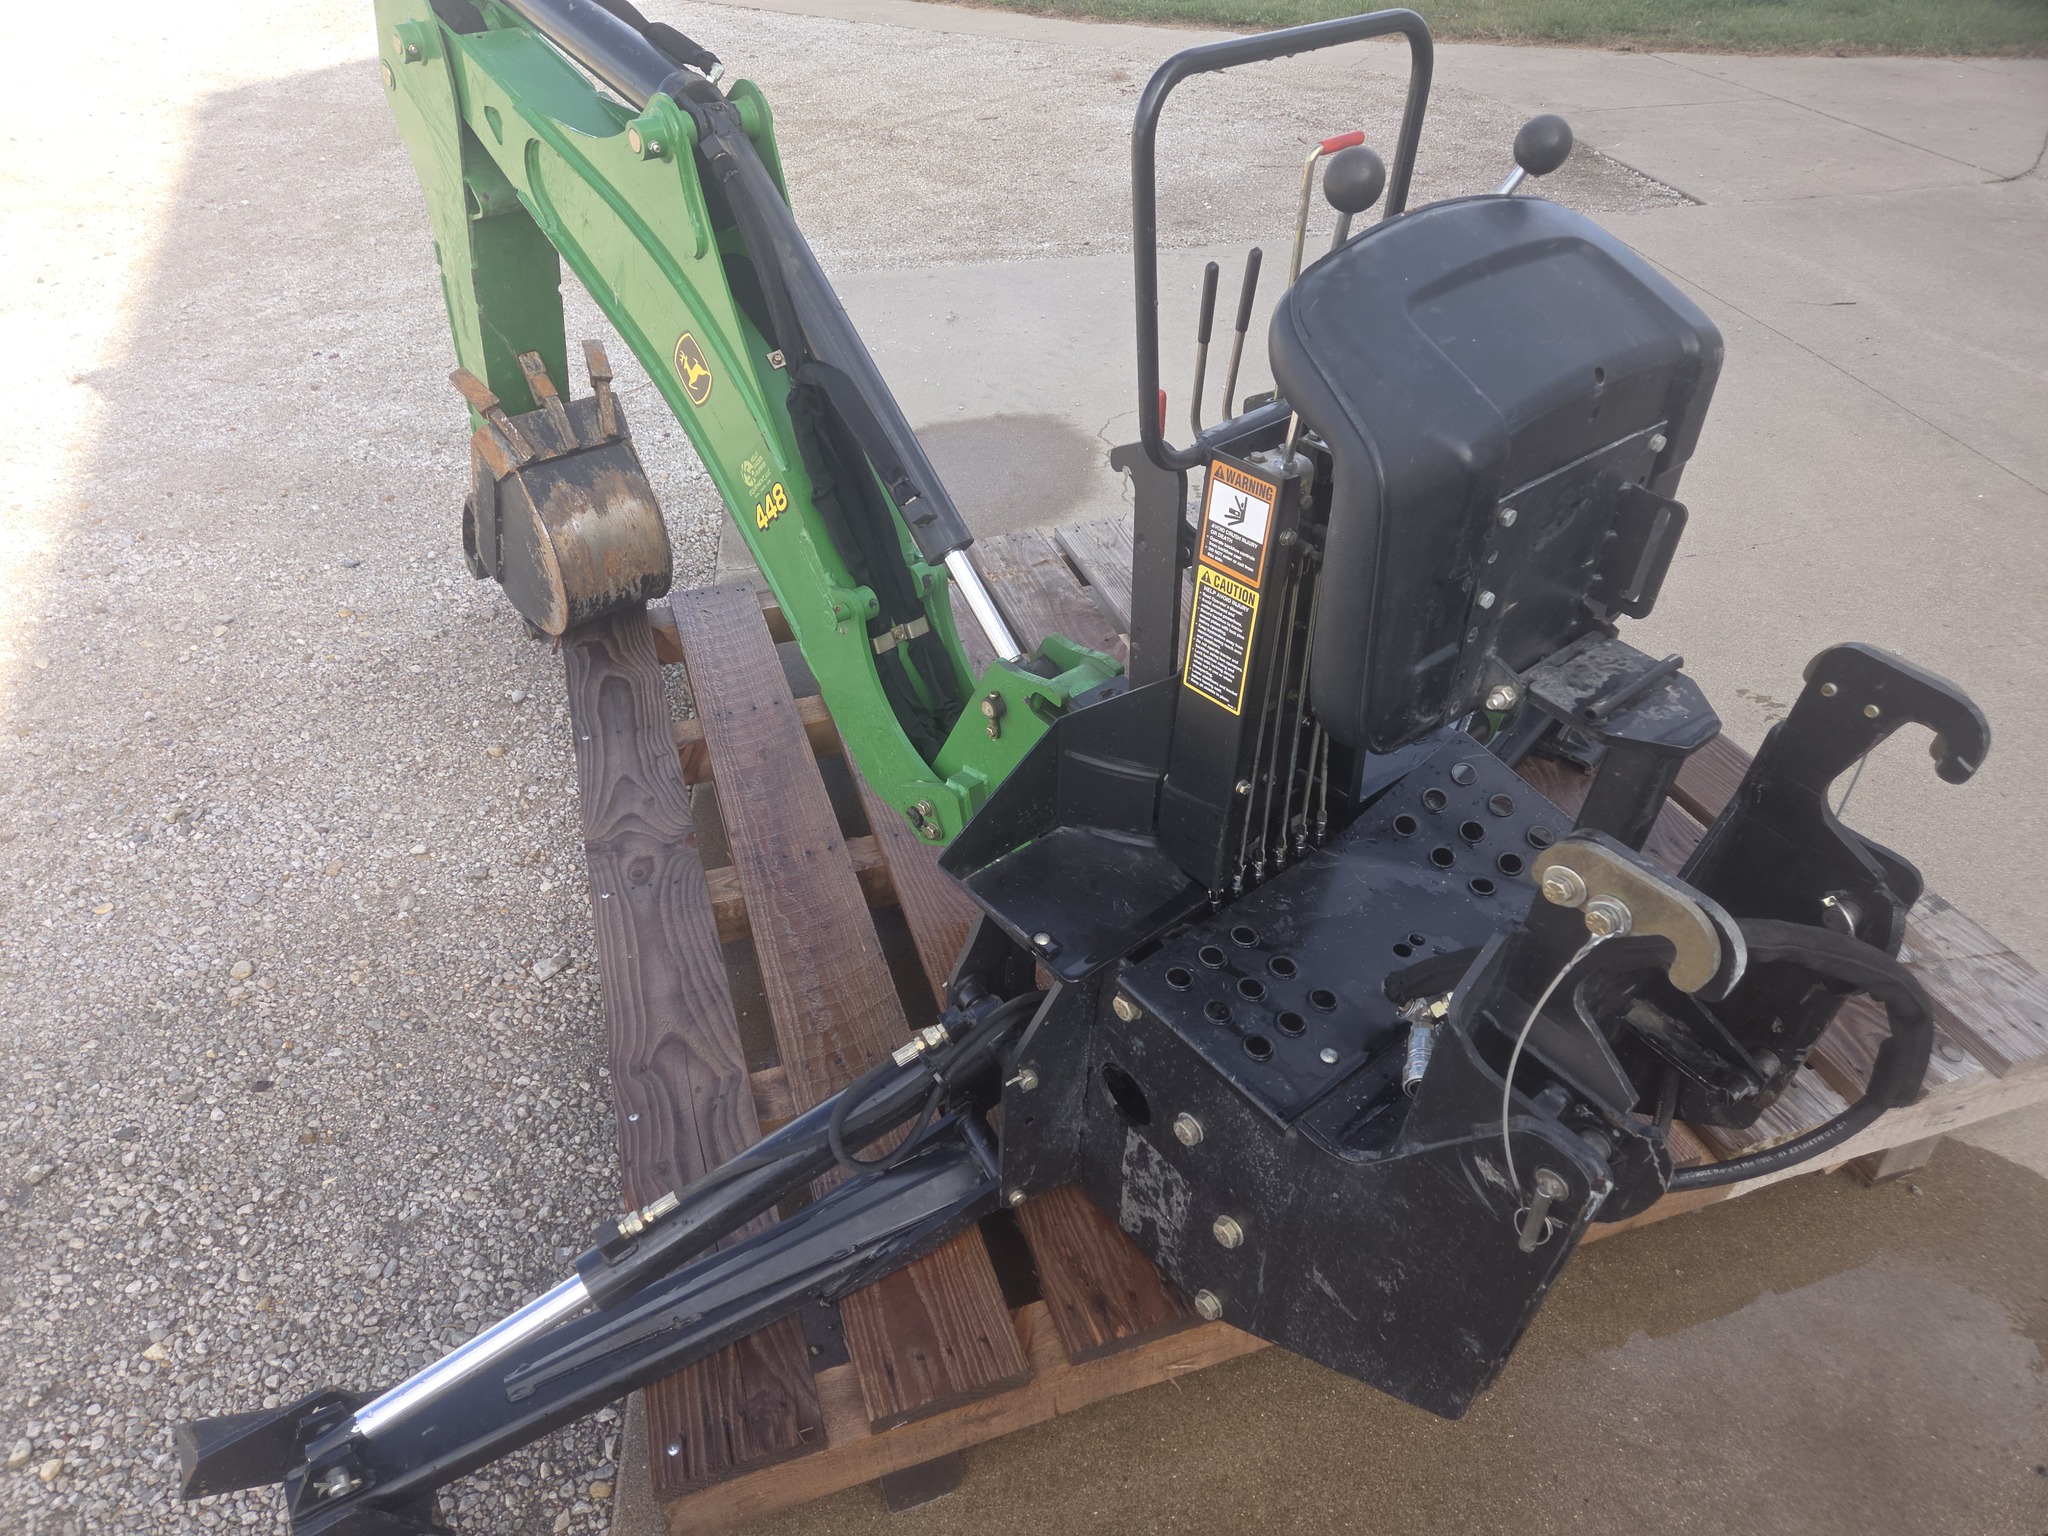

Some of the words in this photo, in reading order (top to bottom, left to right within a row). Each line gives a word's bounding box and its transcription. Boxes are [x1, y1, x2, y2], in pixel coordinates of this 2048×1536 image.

[1225, 468, 1273, 501] WARNING
[755, 482, 789, 532] 448
[1211, 522, 1225, 533] AVOID
[1225, 529, 1241, 541] CRUSH
[1241, 537, 1258, 549] INJURY
[1217, 532, 1232, 543] DEATH
[1203, 585, 1216, 595] HELP
[1216, 592, 1231, 603] AVOID
[1231, 600, 1249, 612] INJURY
[1213, 574, 1255, 606] CAUTION
